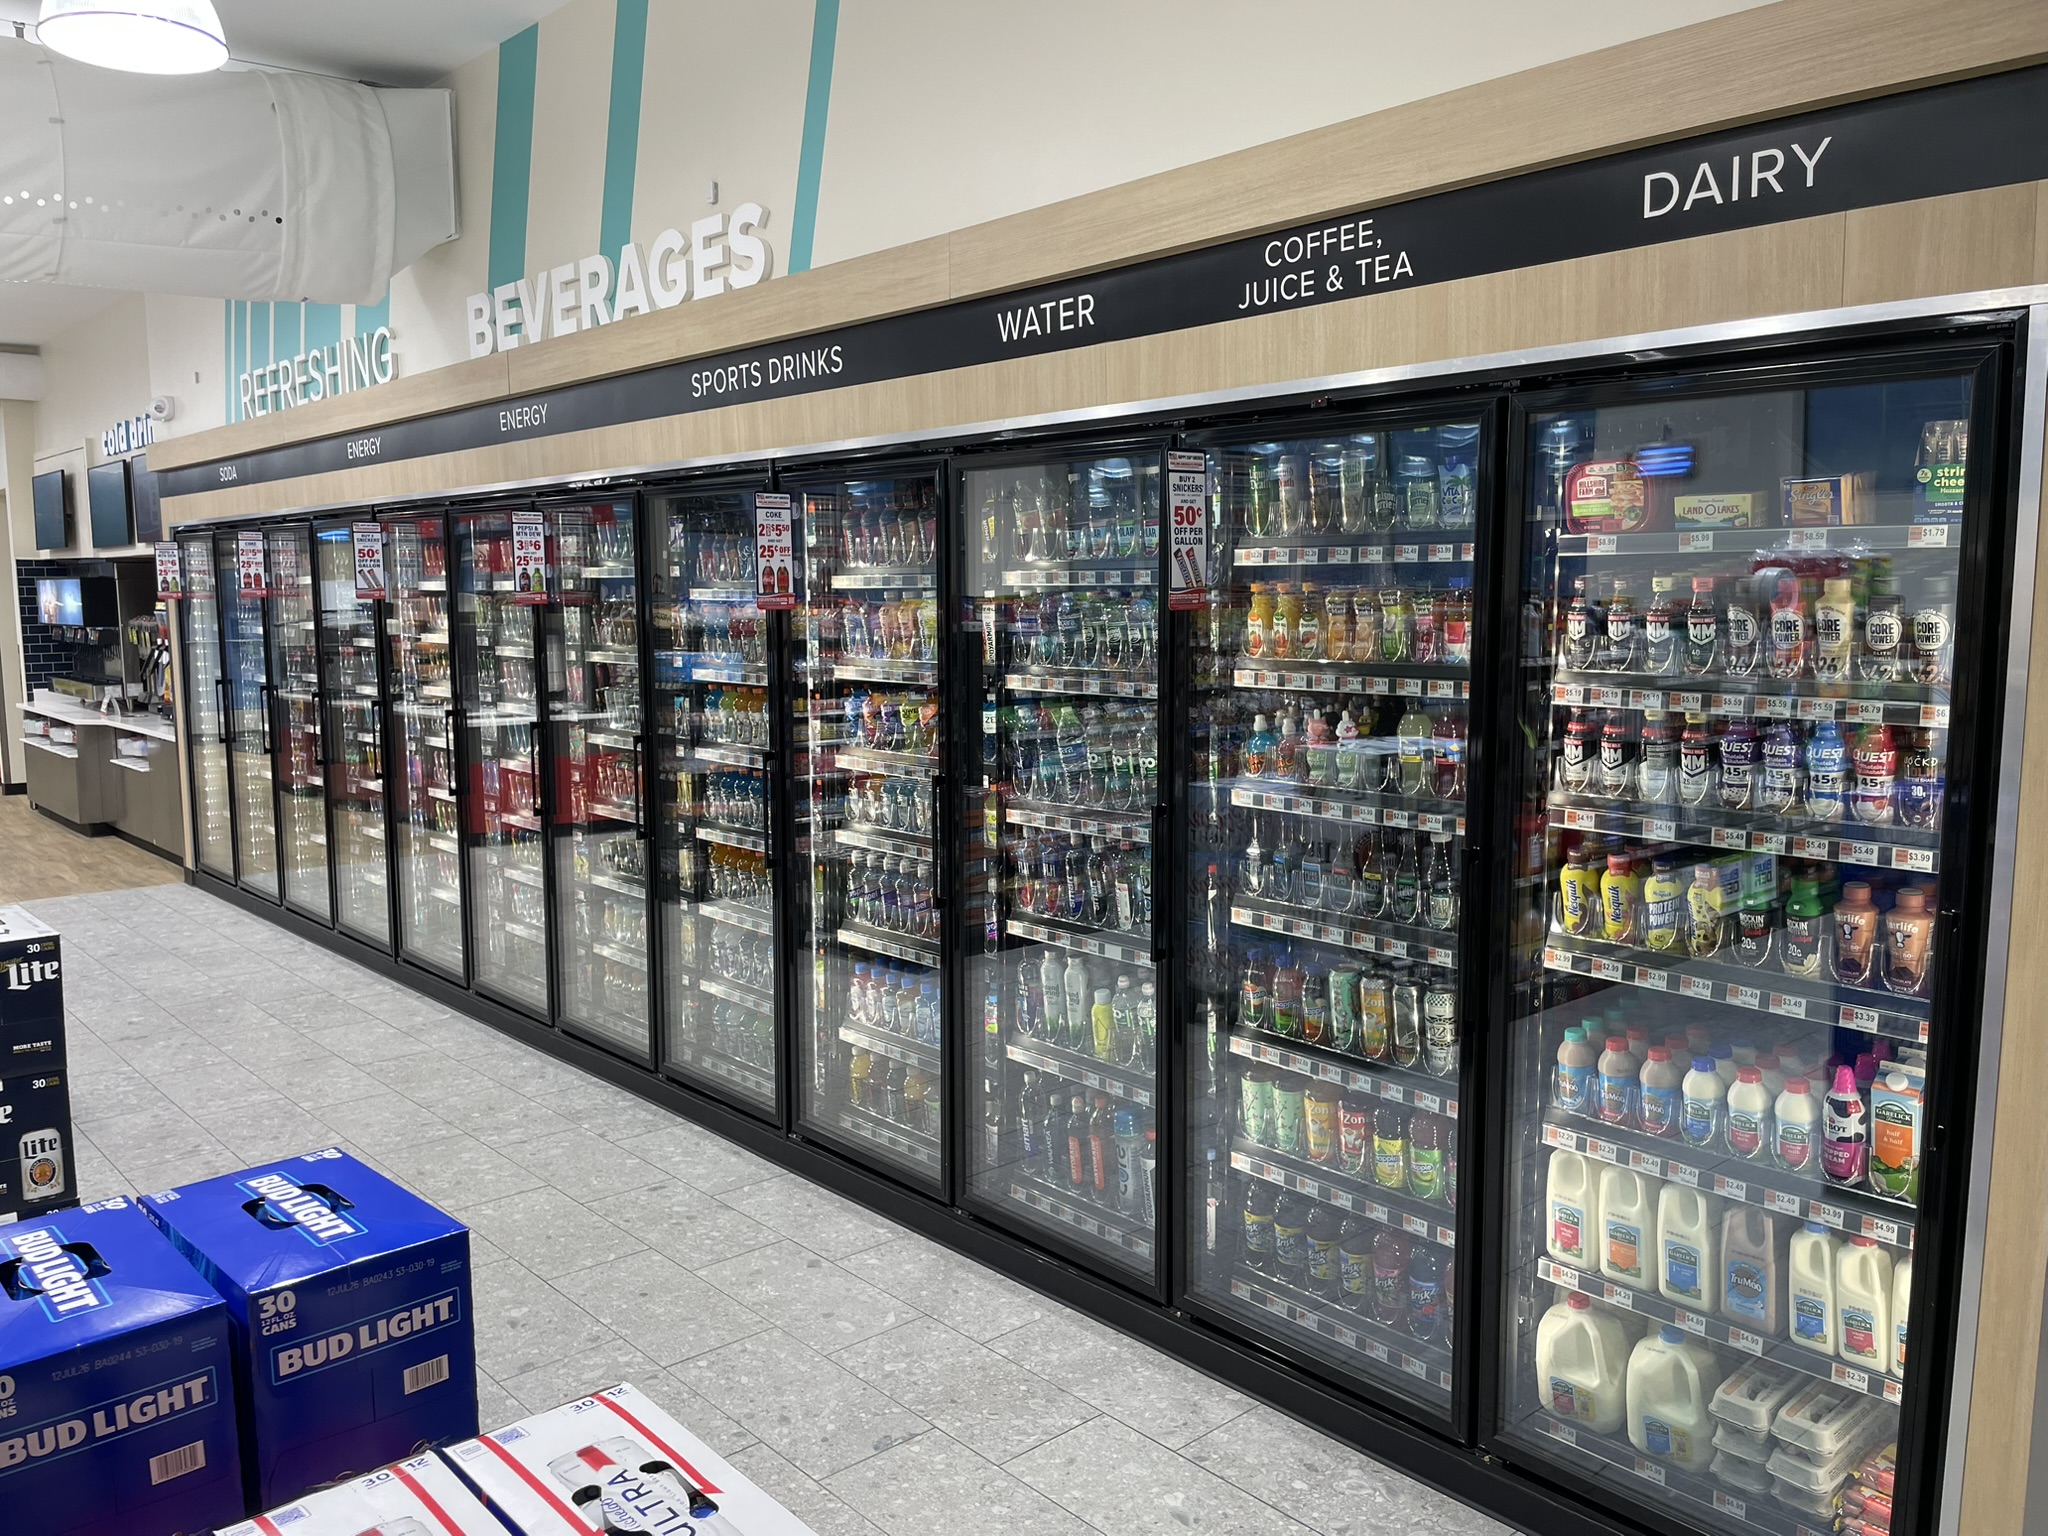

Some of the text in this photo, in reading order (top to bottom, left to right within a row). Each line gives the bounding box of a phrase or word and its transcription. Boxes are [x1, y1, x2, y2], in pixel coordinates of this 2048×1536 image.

[1643, 137, 1833, 219] DAIRY
[1264, 219, 1383, 268] COFFEE,
[467, 203, 771, 359] BEVERAGES
[1238, 251, 1414, 310] JUICE & TEA
[997, 294, 1095, 343] WATER
[240, 326, 398, 420] REFRESHING
[691, 345, 843, 398] SPORTS DRINKS
[500, 403, 548, 431] ENERGY
[102, 419, 129, 456] cold
[347, 437, 381, 459] ENERGY
[219, 466, 237, 481] SODA
[1173, 484, 1203, 492] SNICKERS
[1579, 480, 1606, 489] HILLSHIRE
[1442, 486, 1460, 497] VITA
[1579, 488, 1593, 496] FARM
[1789, 488, 1834, 505] Singles
[1683, 506, 1703, 515] LAND
[1717, 505, 1740, 514] LAKES
[1174, 506, 1202, 526] 50¢
[759, 524, 765, 537] 2
[1174, 527, 1203, 535] OFF PER
[1923, 529, 1945, 537] $1.79
[1175, 536, 1203, 545] GALLON
[1598, 537, 1616, 546] $8.99
[1691, 534, 1710, 542] $5.99
[517, 541, 524, 550] 3
[358, 549, 379, 558] 50¢
[760, 545, 778, 559] 25¢
[516, 555, 533, 566] 25¢
[1774, 619, 1799, 633] CORE
[1817, 618, 1840, 632] CORE
[1870, 622, 1894, 635] CORE
[1916, 621, 1941, 634] CORE
[1774, 633, 1800, 642] POWER
[1818, 632, 1841, 642] POWER
[1870, 634, 1895, 644] POWER
[1917, 634, 1941, 644] POWER
[1405, 681, 1419, 689] $3.19
[1566, 689, 1582, 697] $5.19
[1601, 690, 1618, 698] $5.19
[1643, 692, 1659, 701] $5.19
[1682, 695, 1699, 704] $5.19
[1723, 697, 1742, 706] $5.59
[1768, 700, 1787, 708] $5.59
[1813, 703, 1833, 711] $5.59
[1860, 705, 1881, 714] $6.79
[1719, 741, 1754, 754] QUEST
[1761, 742, 1796, 756] QUEST
[1806, 745, 1844, 759] QUEST
[1852, 749, 1895, 763] QUEST
[1725, 767, 1748, 778] 45g
[1768, 769, 1791, 781] 45g
[1812, 774, 1838, 785] 45g
[1860, 777, 1885, 788] 45g
[1655, 823, 1672, 832] $4.19
[1725, 832, 1744, 841] $5.49
[1764, 836, 1783, 845] $5.49
[1806, 840, 1826, 849] $5.49
[1853, 846, 1874, 855] $5.49
[1908, 853, 1930, 862] $3.99
[1568, 879, 1580, 916] Nesquik
[1609, 885, 1622, 923] Nesquik
[1649, 898, 1680, 915] PROTEIN
[1649, 912, 1675, 926] POWER
[27, 943, 41, 954] 30
[1554, 954, 1571, 962] $2.99
[1602, 963, 1619, 972] $2.99
[8, 960, 60, 991] Lite
[1648, 973, 1666, 982] $2.99
[1692, 981, 1710, 990] $2.99
[1739, 989, 1758, 999] $3.49
[1783, 998, 1802, 1008] $3.49
[1854, 1012, 1875, 1022] $3.39
[13, 1040, 52, 1051] MORE TASTE
[32, 1079, 46, 1089] 30
[1876, 1108, 1912, 1121] GARELICK
[1558, 1133, 1574, 1142] $2.29
[1889, 1137, 1904, 1145] half
[22, 1137, 57, 1160] Lite
[1599, 1144, 1615, 1155] $2.29
[1641, 1157, 1659, 1168] $2.49
[1679, 1167, 1697, 1178] $2.49
[1726, 1180, 1744, 1191] $2.49
[1776, 1194, 1795, 1205] $2.49
[246, 1174, 356, 1239] BUD LIGHT
[1822, 1207, 1842, 1219] $3.99
[1874, 1222, 1895, 1234] $4.99
[11, 1230, 100, 1315] BUD LIGHT
[1561, 1269, 1577, 1280] $4.29
[327, 1279, 360, 1297] 12JUL26
[363, 1270, 394, 1287] BA0243
[1730, 1273, 1762, 1292] TruMoo
[1614, 1289, 1631, 1300] $4.29
[258, 1290, 296, 1319] 30
[262, 1318, 297, 1336] CANS
[278, 1295, 454, 1377] BUD LIGHT
[1741, 1332, 1759, 1345] $4.99
[51, 1363, 90, 1382] 12JUL26
[94, 1350, 132, 1370] BA0244
[1847, 1371, 1866, 1383] $2.39
[606, 1387, 628, 1397] 12
[569, 1399, 596, 1413] 30
[0, 1376, 208, 1469] BUD LIGHT
[405, 1458, 429, 1470] 12
[361, 1472, 391, 1487] 30
[607, 1468, 697, 1536] ULTRA
